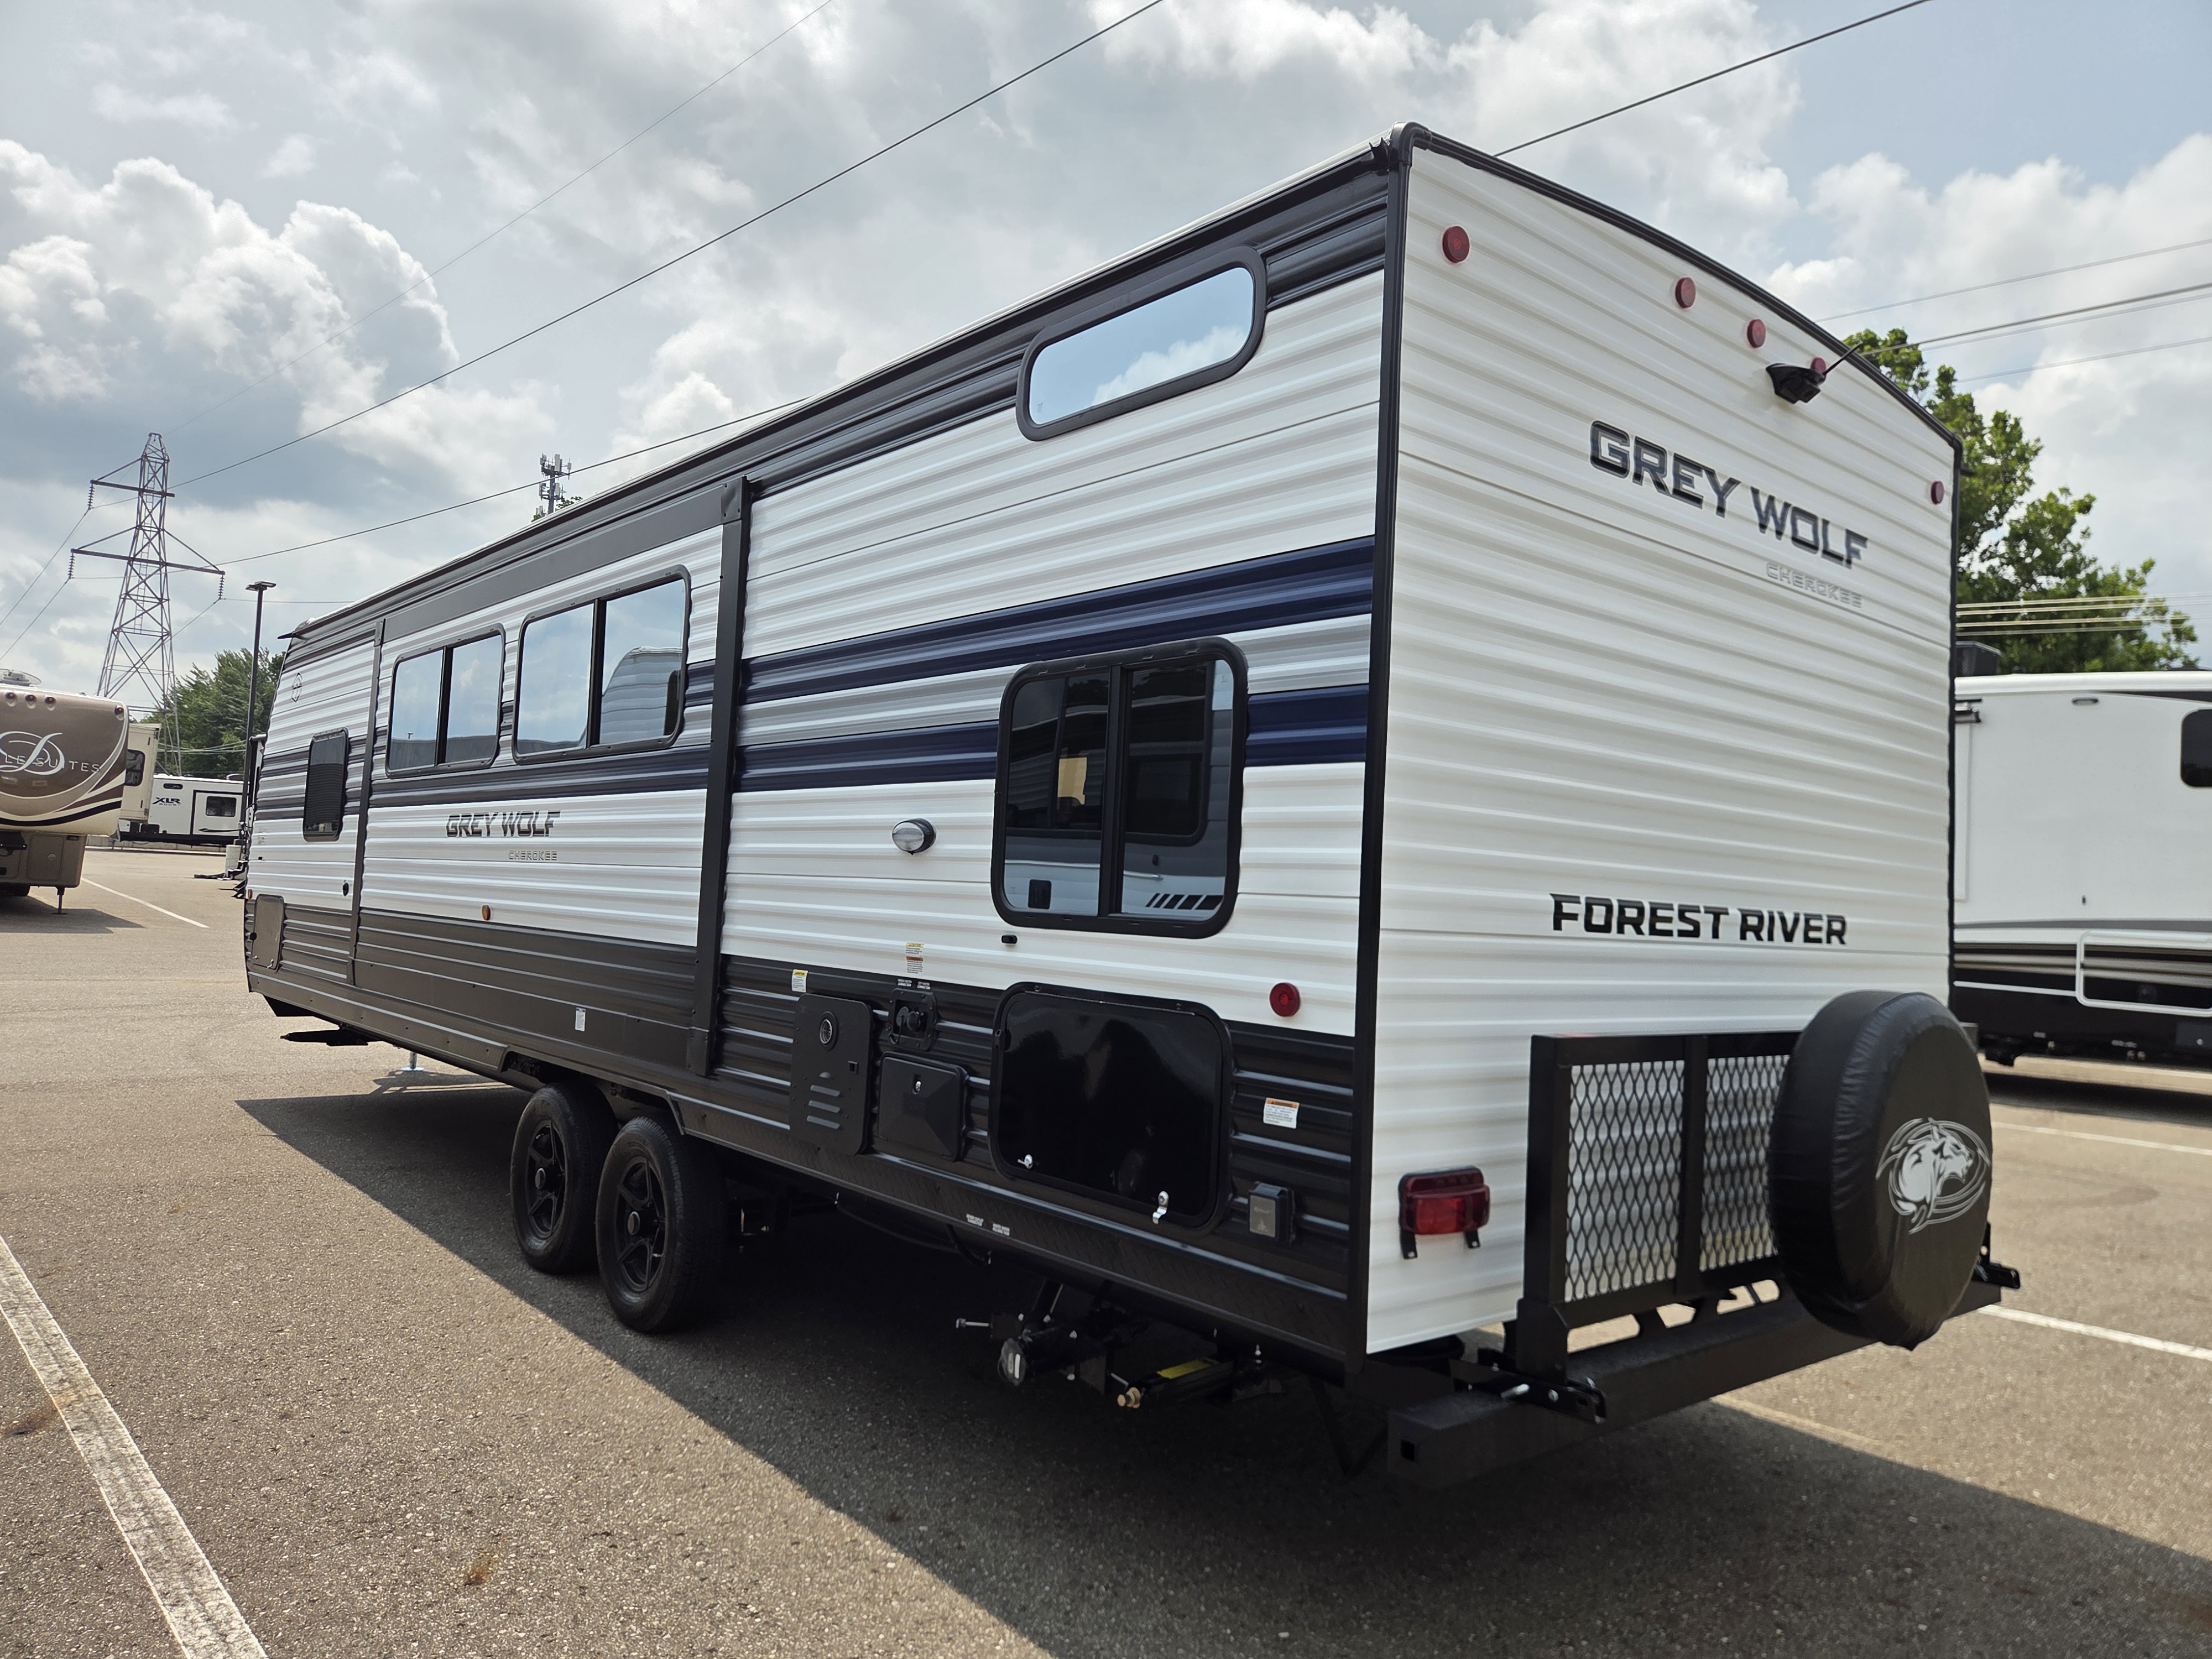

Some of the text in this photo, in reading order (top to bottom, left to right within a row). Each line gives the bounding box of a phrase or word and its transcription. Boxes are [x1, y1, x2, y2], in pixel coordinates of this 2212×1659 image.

[1589, 420, 1869, 570] GREY WOLF
[1766, 562, 1863, 608] CHEROKEE
[35, 758, 100, 773] SUTES
[446, 810, 561, 837] GREY WOLF
[508, 851, 557, 861] CHEROKEE
[1549, 893, 1848, 945] FOREST RIVER
